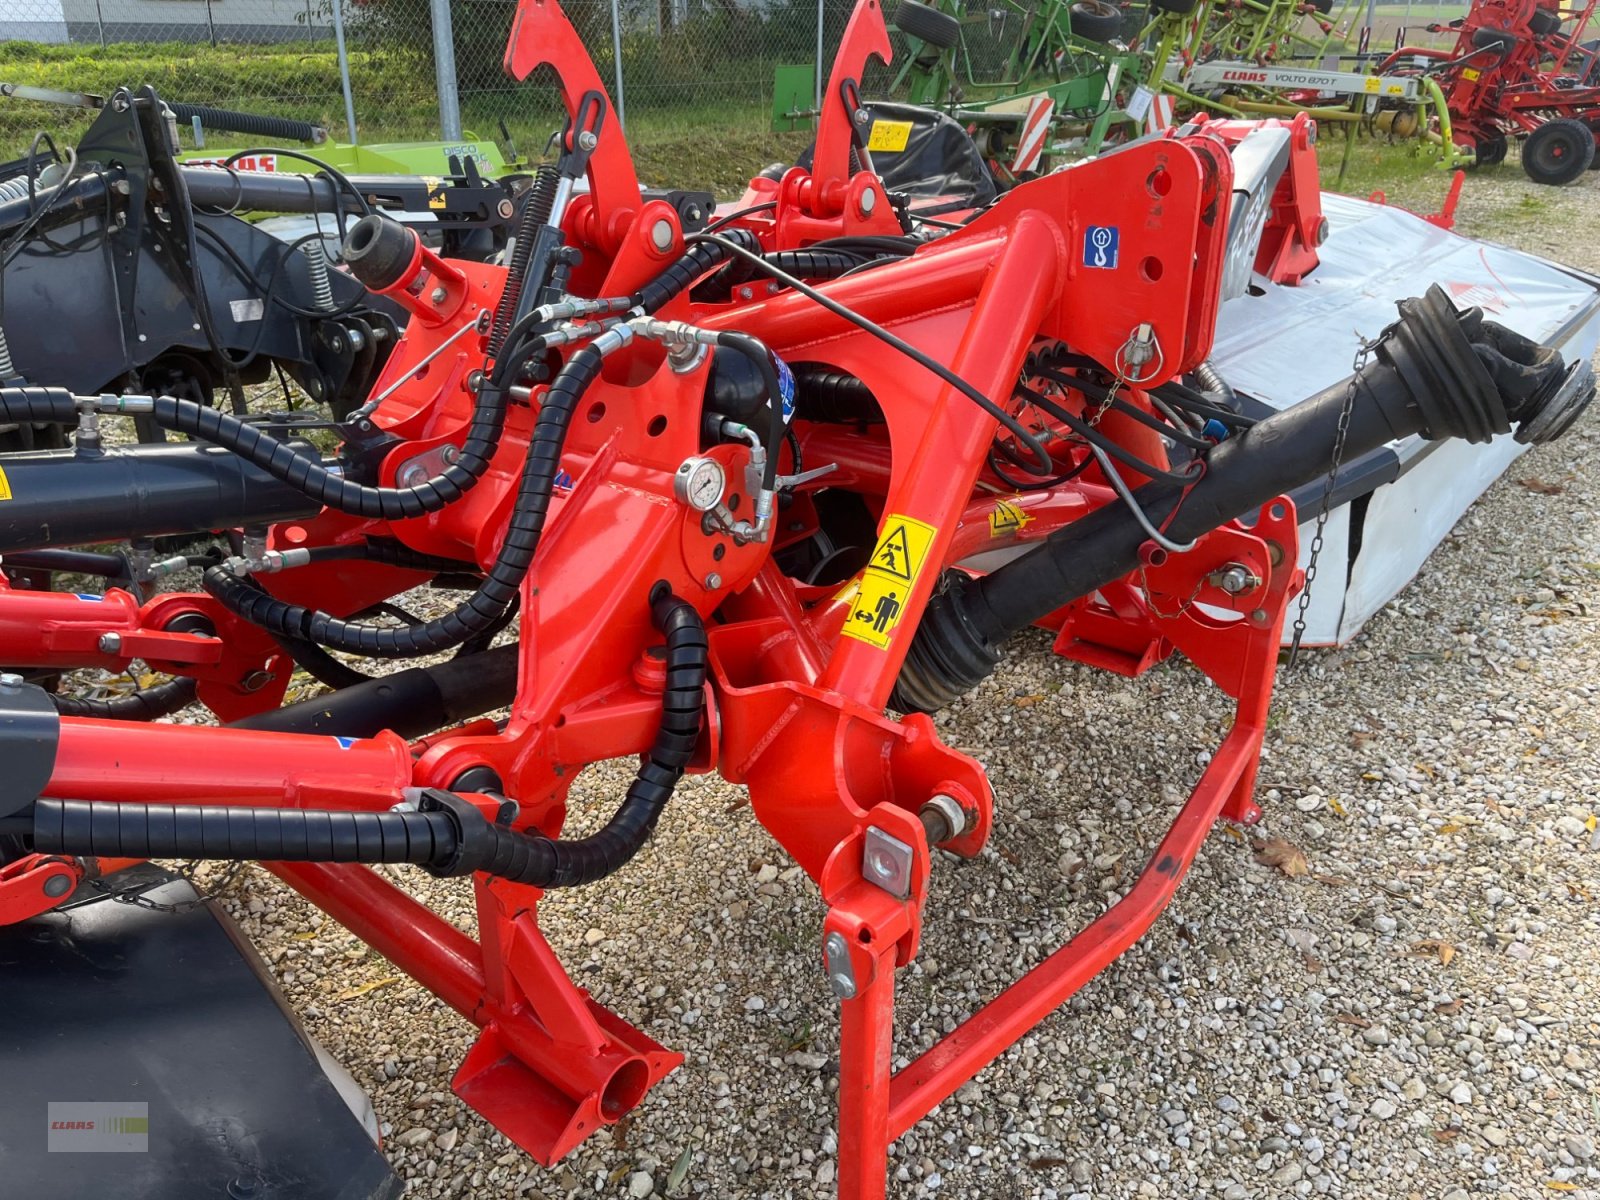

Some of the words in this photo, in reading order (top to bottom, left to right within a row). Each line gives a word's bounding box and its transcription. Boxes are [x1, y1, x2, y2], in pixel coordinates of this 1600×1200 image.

[1222, 71, 1268, 83] CLAAS
[1275, 74, 1306, 84] VOLTO
[1308, 77, 1329, 85] 870
[1329, 78, 1337, 86] T
[443, 144, 477, 156] DISCO
